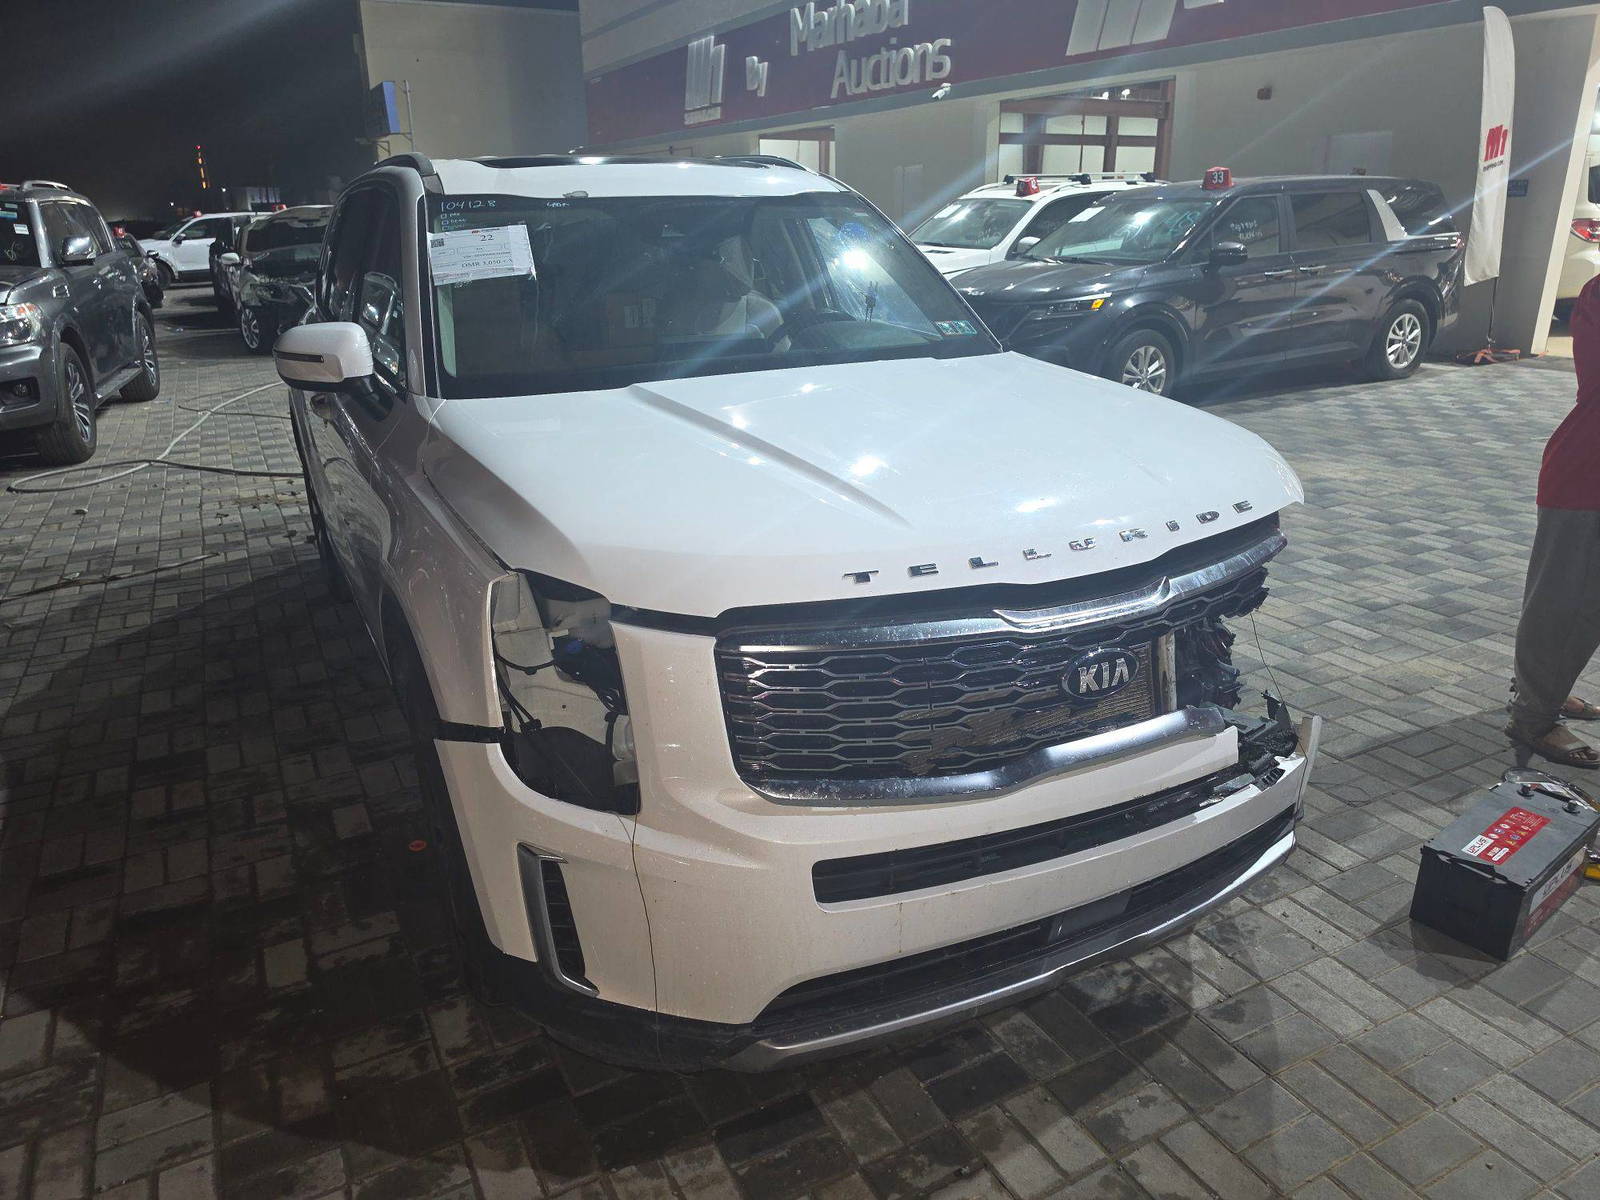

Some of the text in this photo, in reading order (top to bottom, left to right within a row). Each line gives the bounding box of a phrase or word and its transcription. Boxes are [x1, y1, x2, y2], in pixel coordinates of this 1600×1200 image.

[789, 0, 909, 57] Marhaba
[745, 56, 768, 97] By
[830, 37, 952, 99] Auctions
[1212, 171, 1224, 184] 33
[479, 234, 495, 242] 22
[841, 499, 1254, 584] TELLURIDE
[1078, 657, 1129, 694] KIA
[1467, 837, 1487, 854] UPLUS
